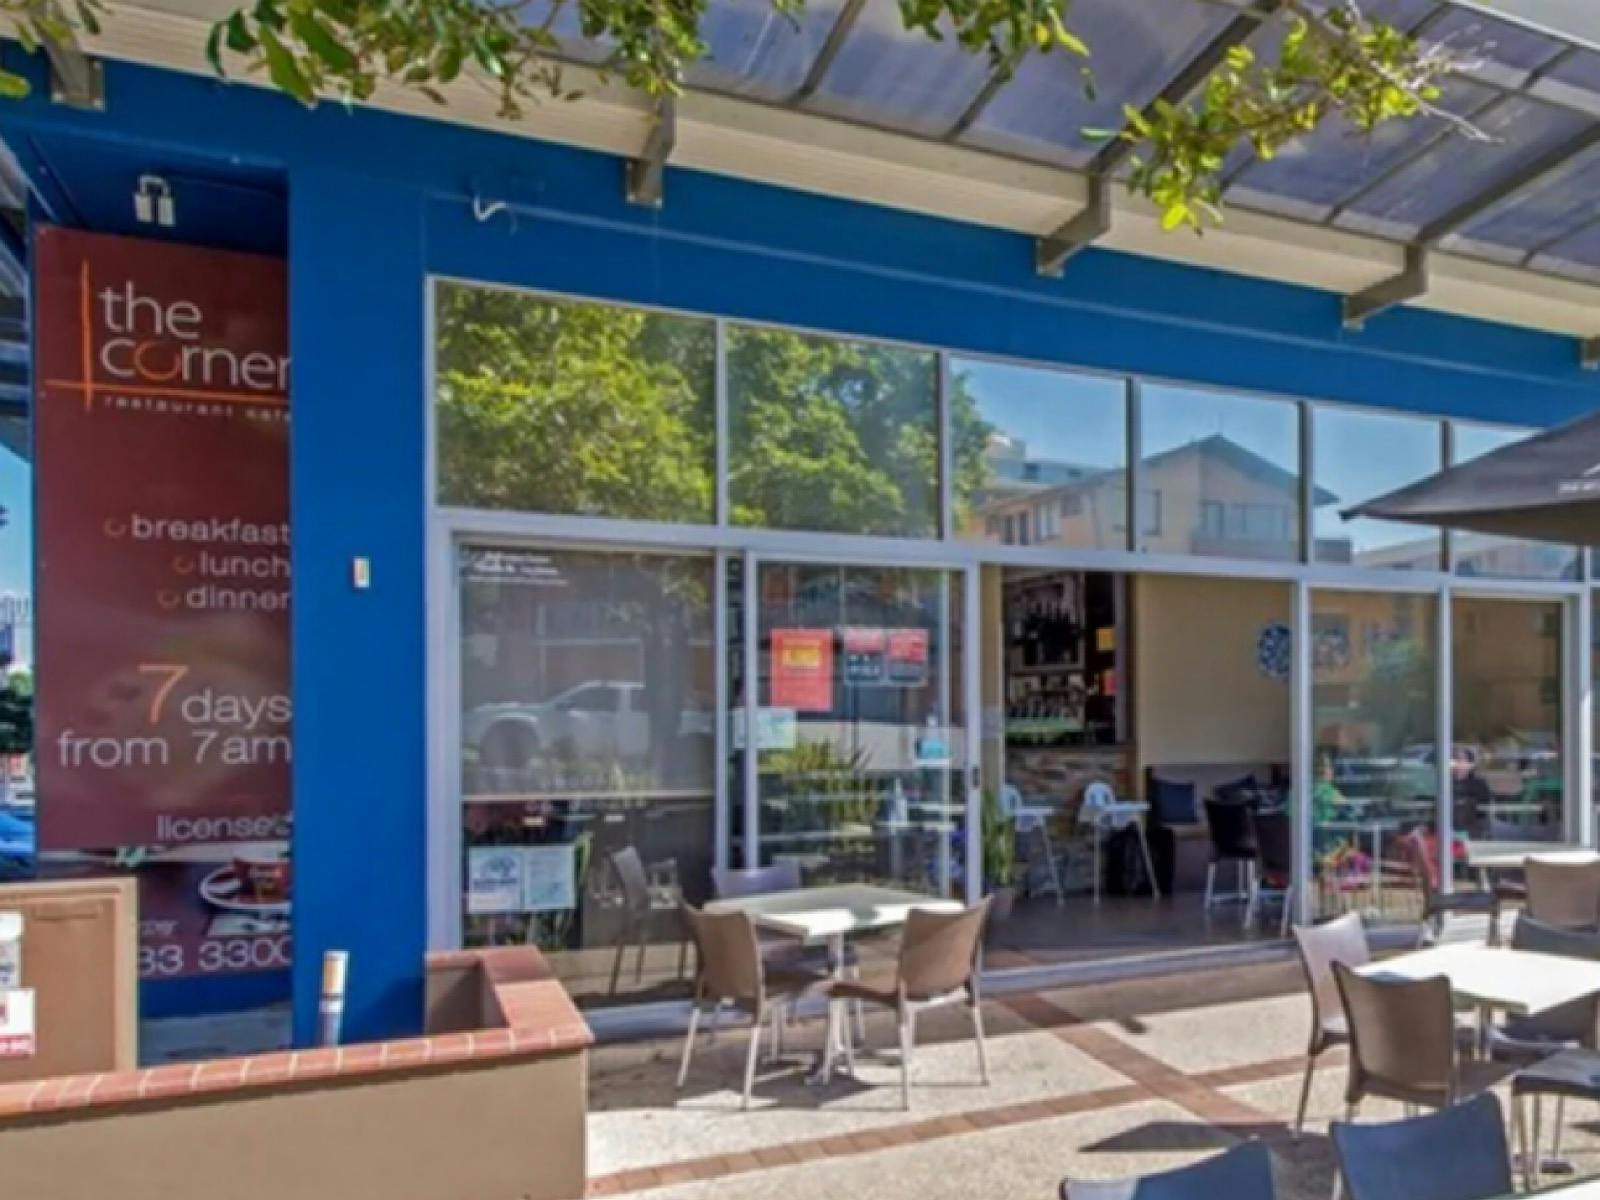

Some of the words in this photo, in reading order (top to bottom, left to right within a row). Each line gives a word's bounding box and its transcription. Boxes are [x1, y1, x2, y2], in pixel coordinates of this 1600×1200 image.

[99, 280, 202, 339] the
[101, 338, 291, 389] corner
[131, 514, 291, 545] breakfast
[200, 551, 291, 578] lunch
[186, 584, 291, 610] dinner
[137, 664, 189, 724] 7
[181, 688, 292, 731] days
[57, 729, 169, 767] from
[191, 731, 292, 765] 7am
